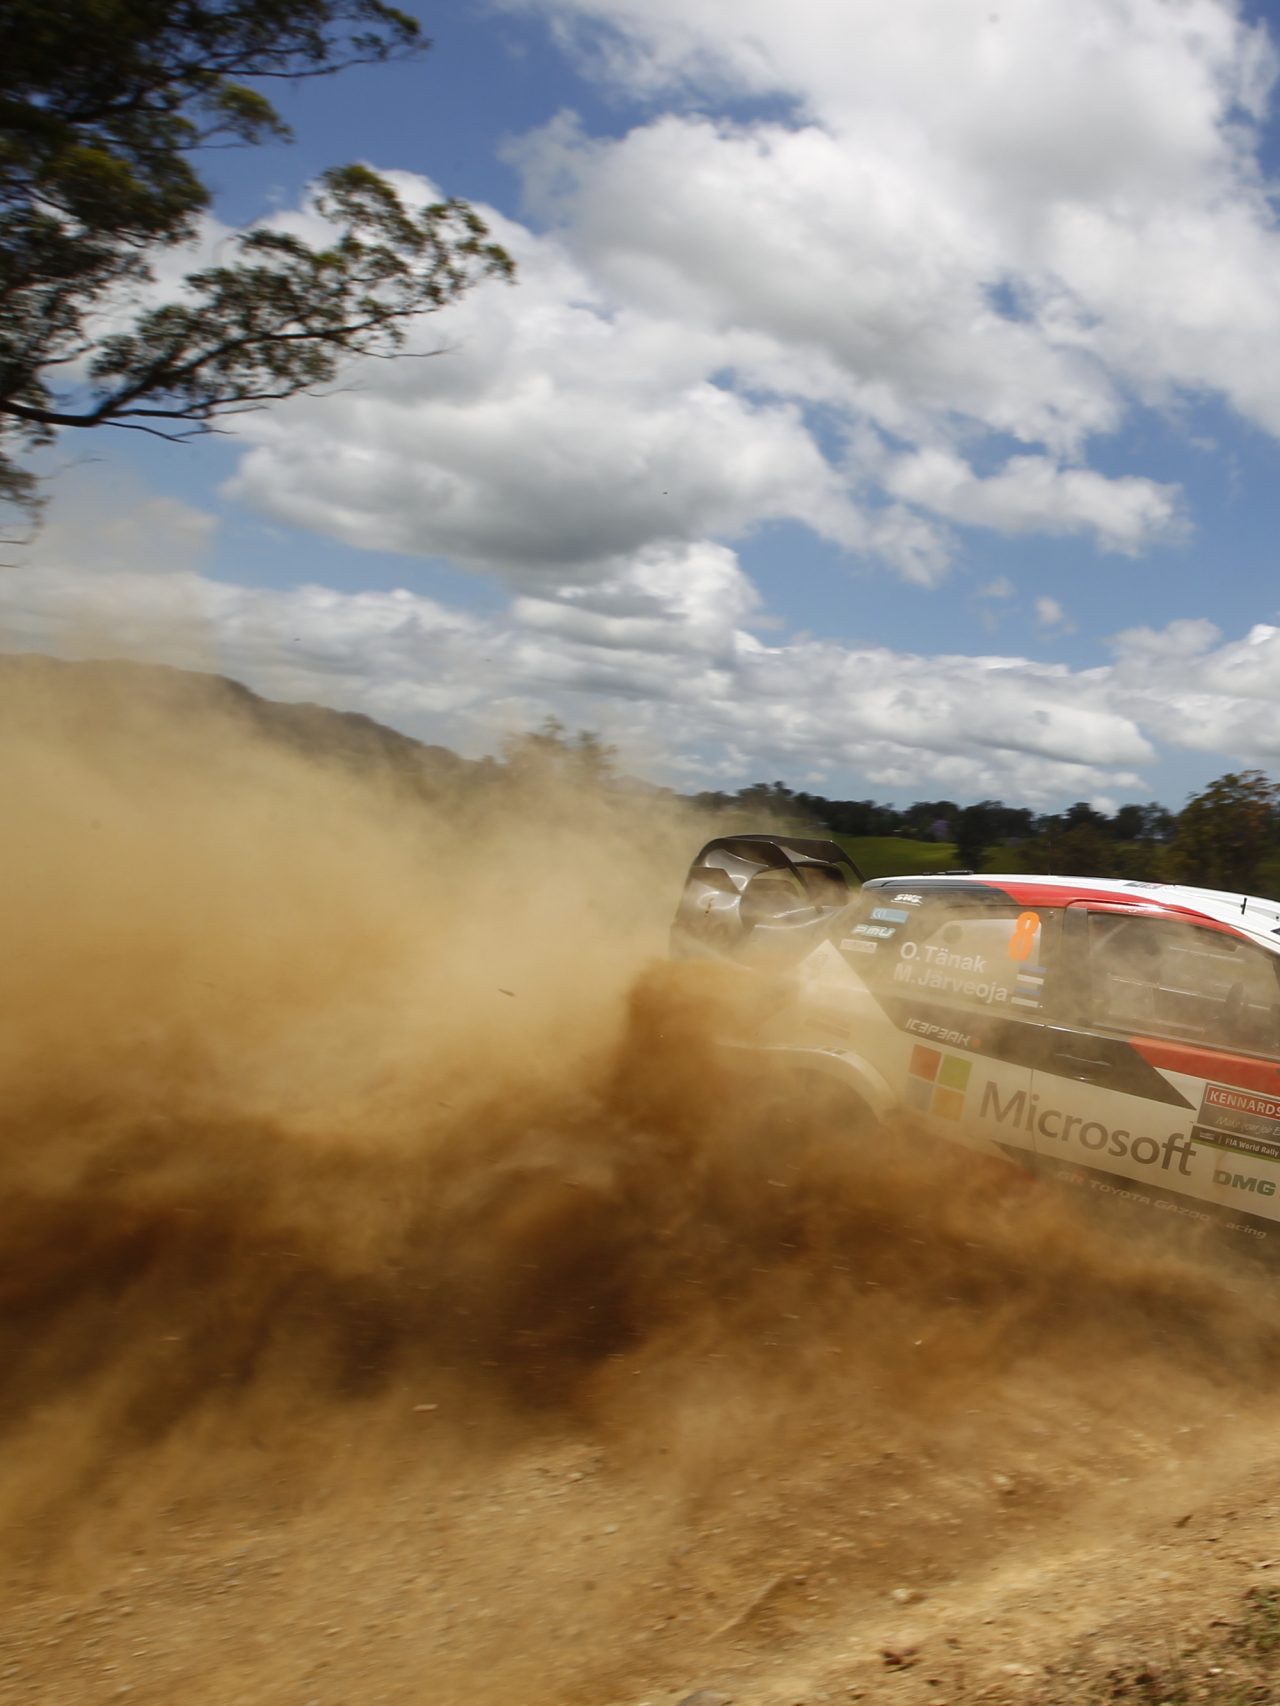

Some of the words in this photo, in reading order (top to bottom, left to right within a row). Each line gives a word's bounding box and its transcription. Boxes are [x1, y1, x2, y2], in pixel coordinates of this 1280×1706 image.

[1008, 911, 1040, 961] 8
[978, 1080, 1197, 1177] Microsoft
[1225, 1138, 1238, 1147] FIA
[1239, 1140, 1260, 1153] World
[1261, 1146, 1280, 1159] Rally
[1212, 1169, 1277, 1197] DMG
